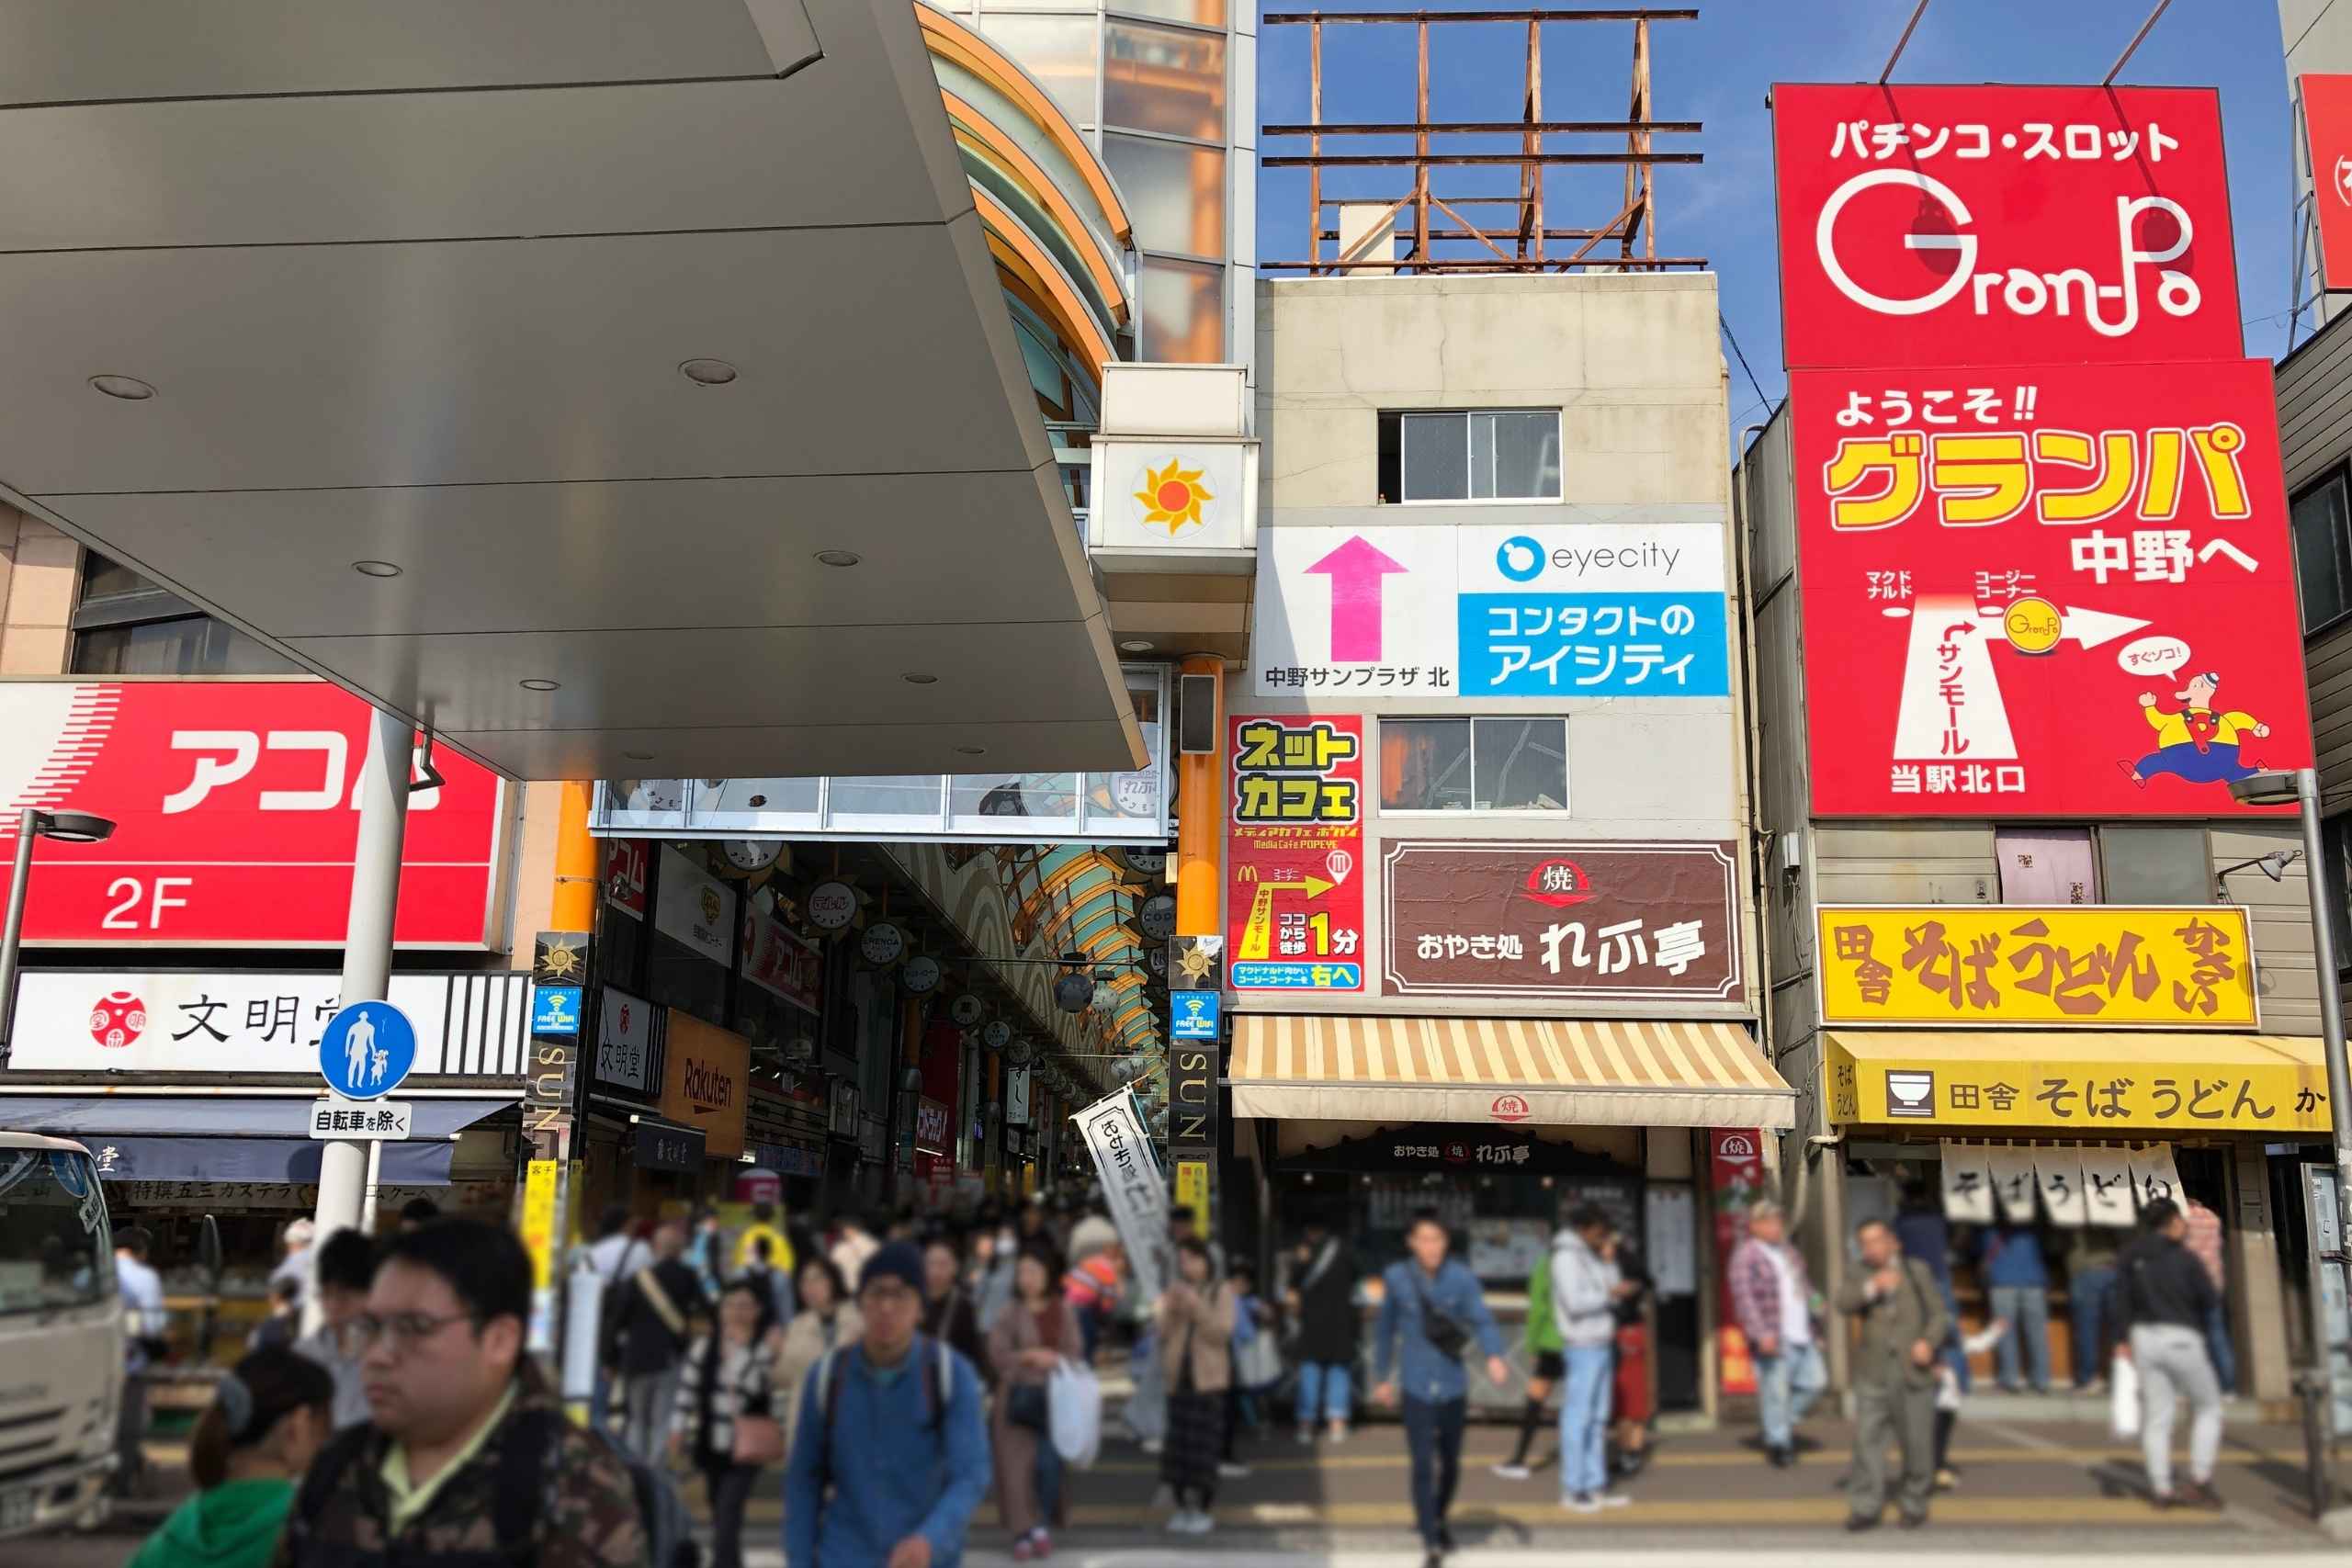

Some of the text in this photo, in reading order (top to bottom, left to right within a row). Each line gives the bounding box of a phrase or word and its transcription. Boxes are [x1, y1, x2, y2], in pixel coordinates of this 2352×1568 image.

[1829, 120, 2178, 162] パチンコ・スロット
[1824, 422, 2251, 531] グランパ
[1552, 542, 1680, 577] eyecity
[2071, 529, 2259, 584] 中野へ
[1866, 570, 1911, 584] マクド
[1867, 585, 1912, 599] ナルド
[1975, 570, 2036, 584] コージー
[1976, 584, 2037, 599] コーナー
[1487, 604, 1695, 637] コンタクトの
[1265, 666, 1450, 689] 中野サンプラザ 北
[1488, 646, 1695, 686] アイシティ
[1936, 644, 1970, 756] サンモール
[1240, 725, 1354, 770] ネット
[1891, 764, 2027, 795] 当駅北口
[1240, 778, 1354, 821] カフェ
[1300, 840, 1339, 850] POPEYE
[1544, 865, 1573, 891] 焼
[101, 877, 193, 930] 2F
[1250, 888, 1271, 952] 中野サンモール
[1279, 912, 1306, 927] ココ
[1279, 941, 1306, 955] 徒歩
[1280, 927, 1306, 941] から
[1308, 911, 1330, 956] 1
[1332, 928, 1359, 955] 分
[1417, 933, 1523, 961] おやき処
[1310, 964, 1355, 987] 右へ
[1834, 924, 1893, 1005] 田舎
[1902, 919, 2161, 1015] そばうどん
[600, 1038, 641, 1079] 文明堂
[532, 1047, 566, 1134] SUN
[683, 1057, 733, 1108] Rakuten
[1179, 1053, 1206, 1142] SUN
[1950, 1082, 2020, 1111] 田舎
[2036, 1078, 2134, 1118] そば
[2153, 1078, 2276, 1119] うどん
[316, 1109, 405, 1132] 自転車を除く
[1393, 1145, 1440, 1158] おやき処
